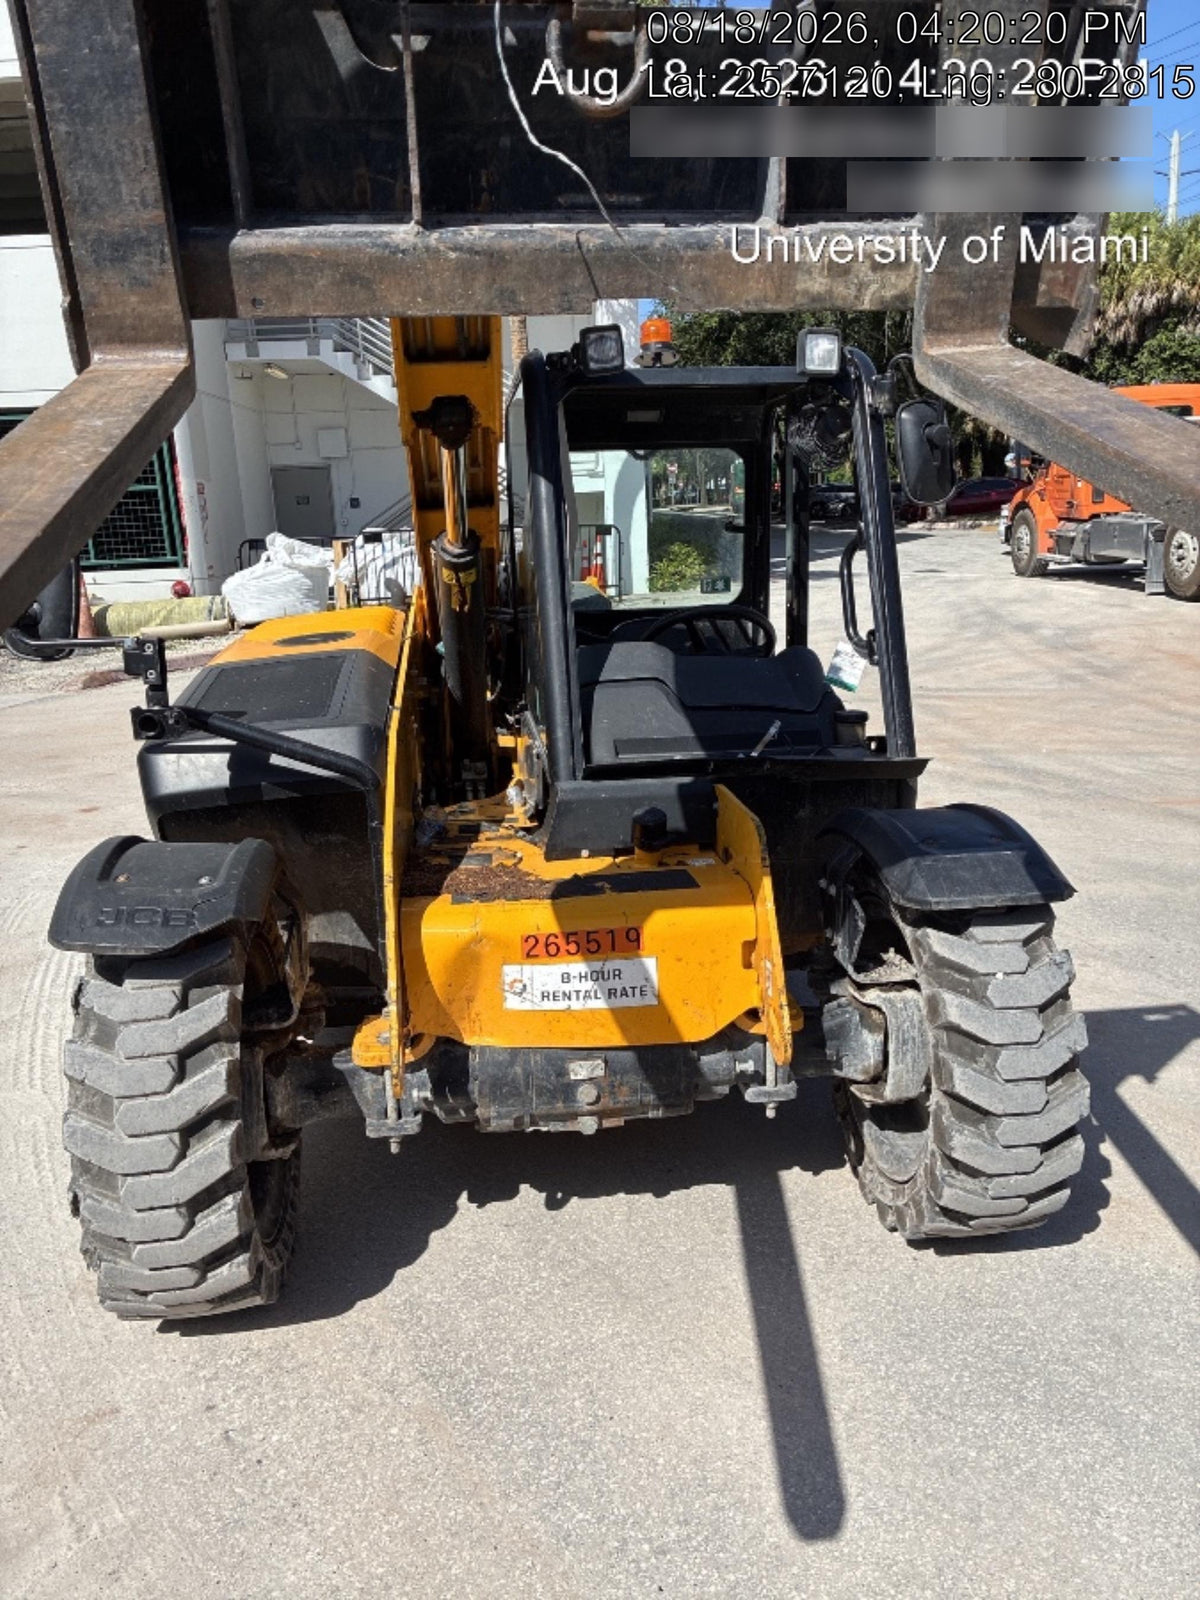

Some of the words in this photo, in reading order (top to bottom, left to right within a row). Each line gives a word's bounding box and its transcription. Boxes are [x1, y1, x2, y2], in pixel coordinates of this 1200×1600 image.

[98, 906, 197, 927] JCB
[524, 927, 641, 959] 265519
[541, 989, 602, 1002] RENTAL
[607, 985, 648, 1000] RATE
